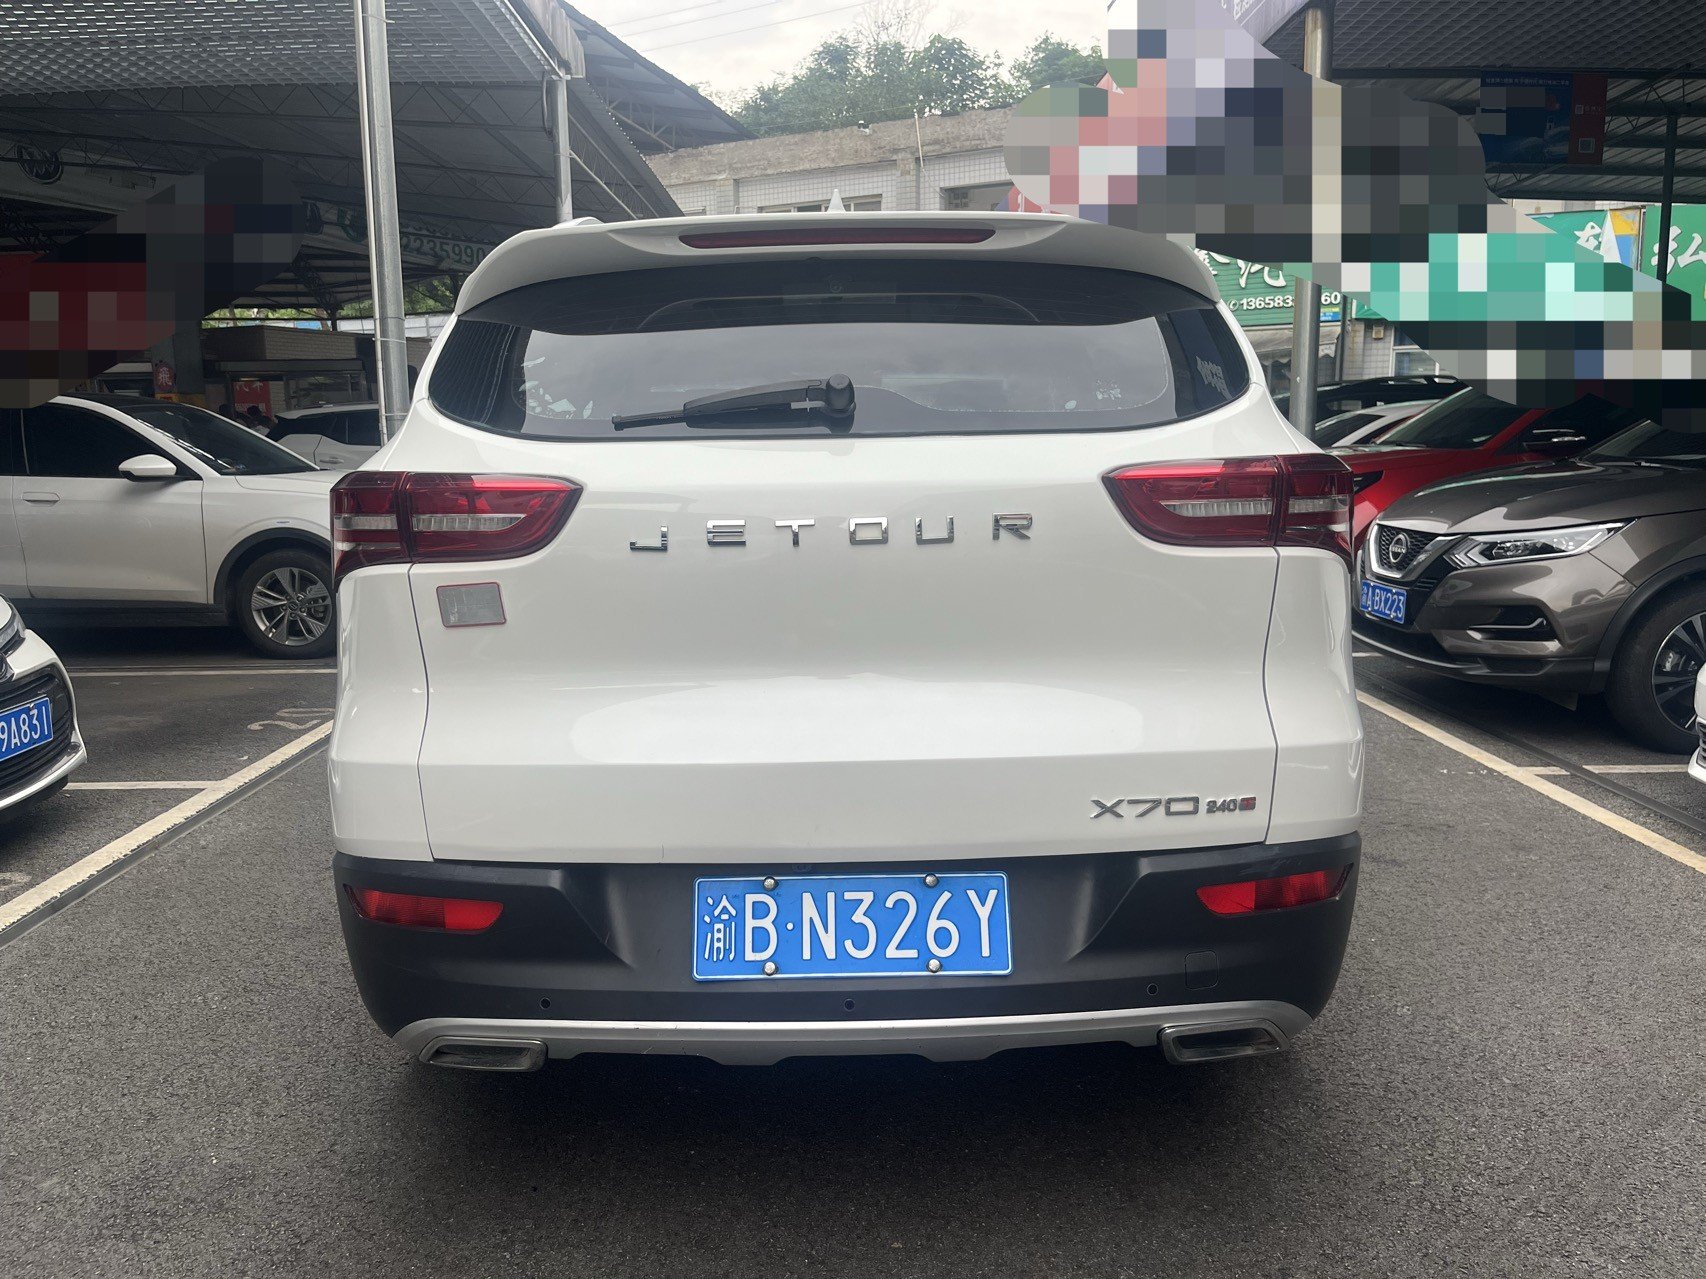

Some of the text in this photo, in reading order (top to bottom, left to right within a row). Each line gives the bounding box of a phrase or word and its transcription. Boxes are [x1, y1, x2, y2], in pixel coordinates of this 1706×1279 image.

[629, 512, 1033, 552] JETOUR
[1090, 797, 1200, 819] X70
[703, 888, 999, 962] 渝B·N326Y
